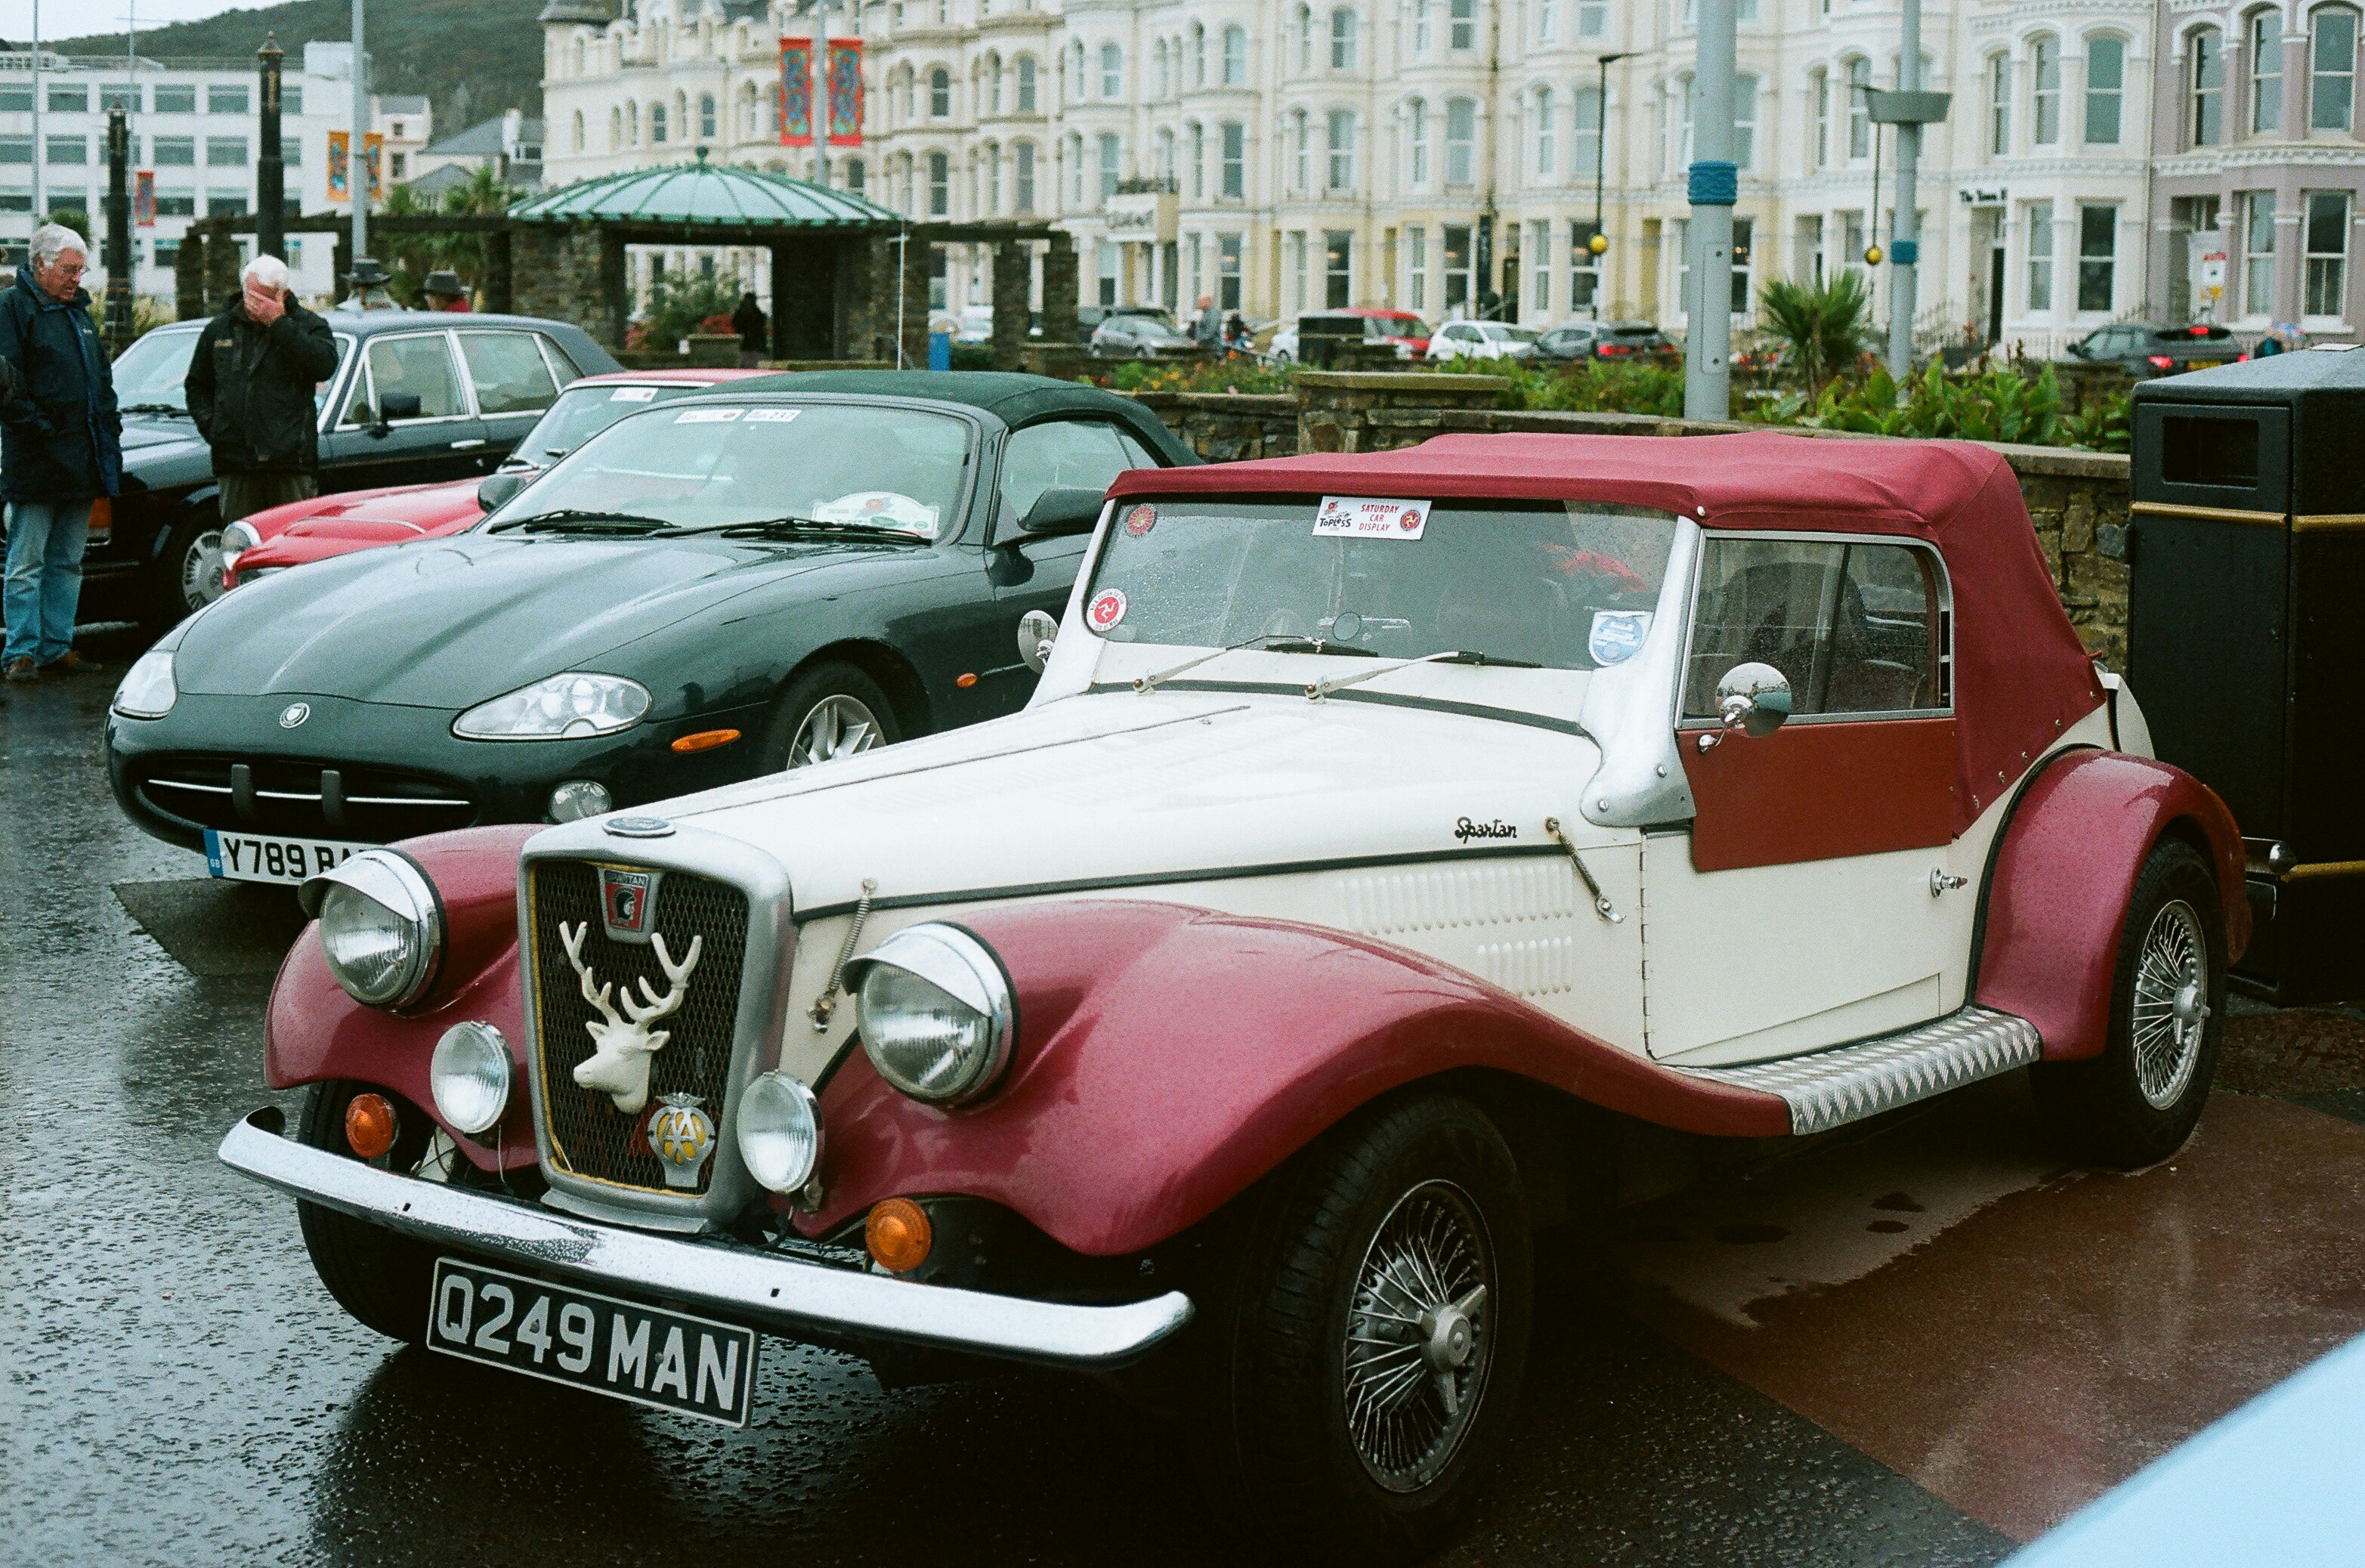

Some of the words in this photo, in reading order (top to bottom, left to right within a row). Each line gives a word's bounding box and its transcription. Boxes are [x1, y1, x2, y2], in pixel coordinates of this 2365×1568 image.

[1361, 504, 1399, 514] SATURDAY
[1370, 514, 1384, 522] CAR
[1359, 523, 1390, 532] DISPLAY
[1455, 816, 1517, 844] Spartan
[224, 837, 308, 878] Y789
[210, 858, 221, 868] GB
[437, 1274, 595, 1374] Q249
[607, 1313, 739, 1412] MAN
